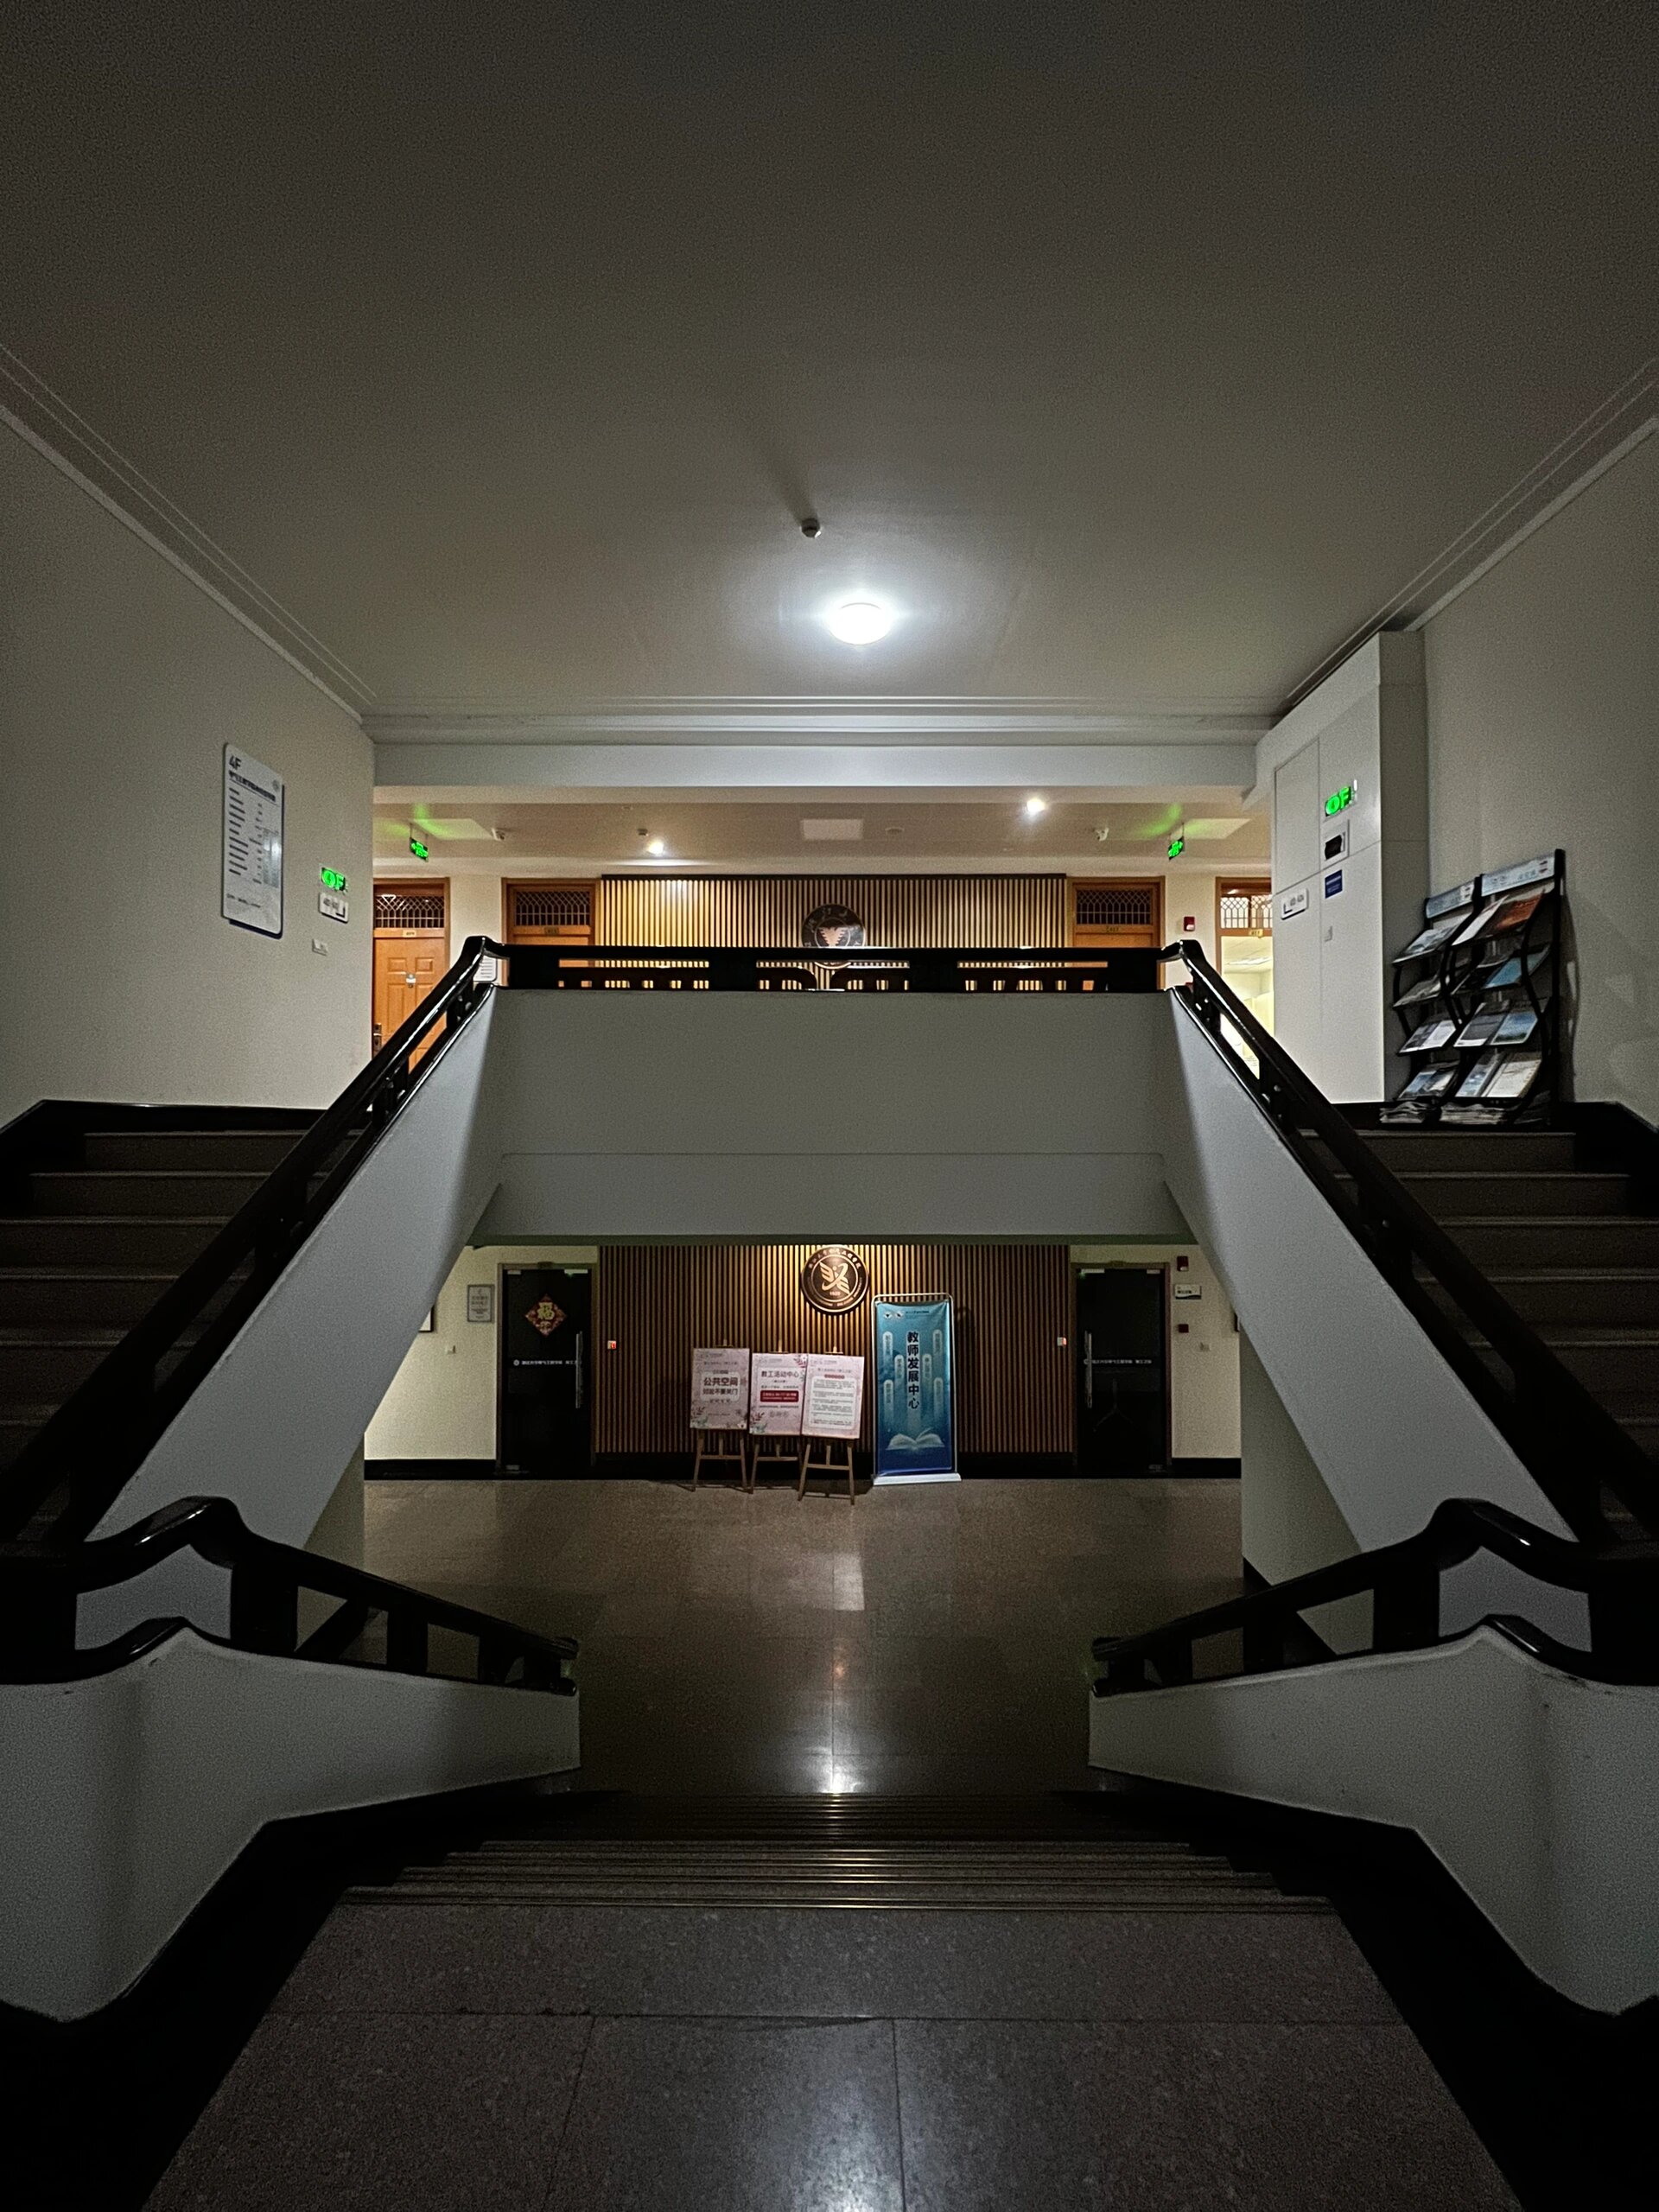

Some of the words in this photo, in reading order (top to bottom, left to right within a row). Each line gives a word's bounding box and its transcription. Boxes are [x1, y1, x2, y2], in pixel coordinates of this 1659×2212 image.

[229, 755, 242, 770] 4F
[907, 1332, 920, 1409] 教师发展中心
[703, 1377, 738, 1387] 公共空间
